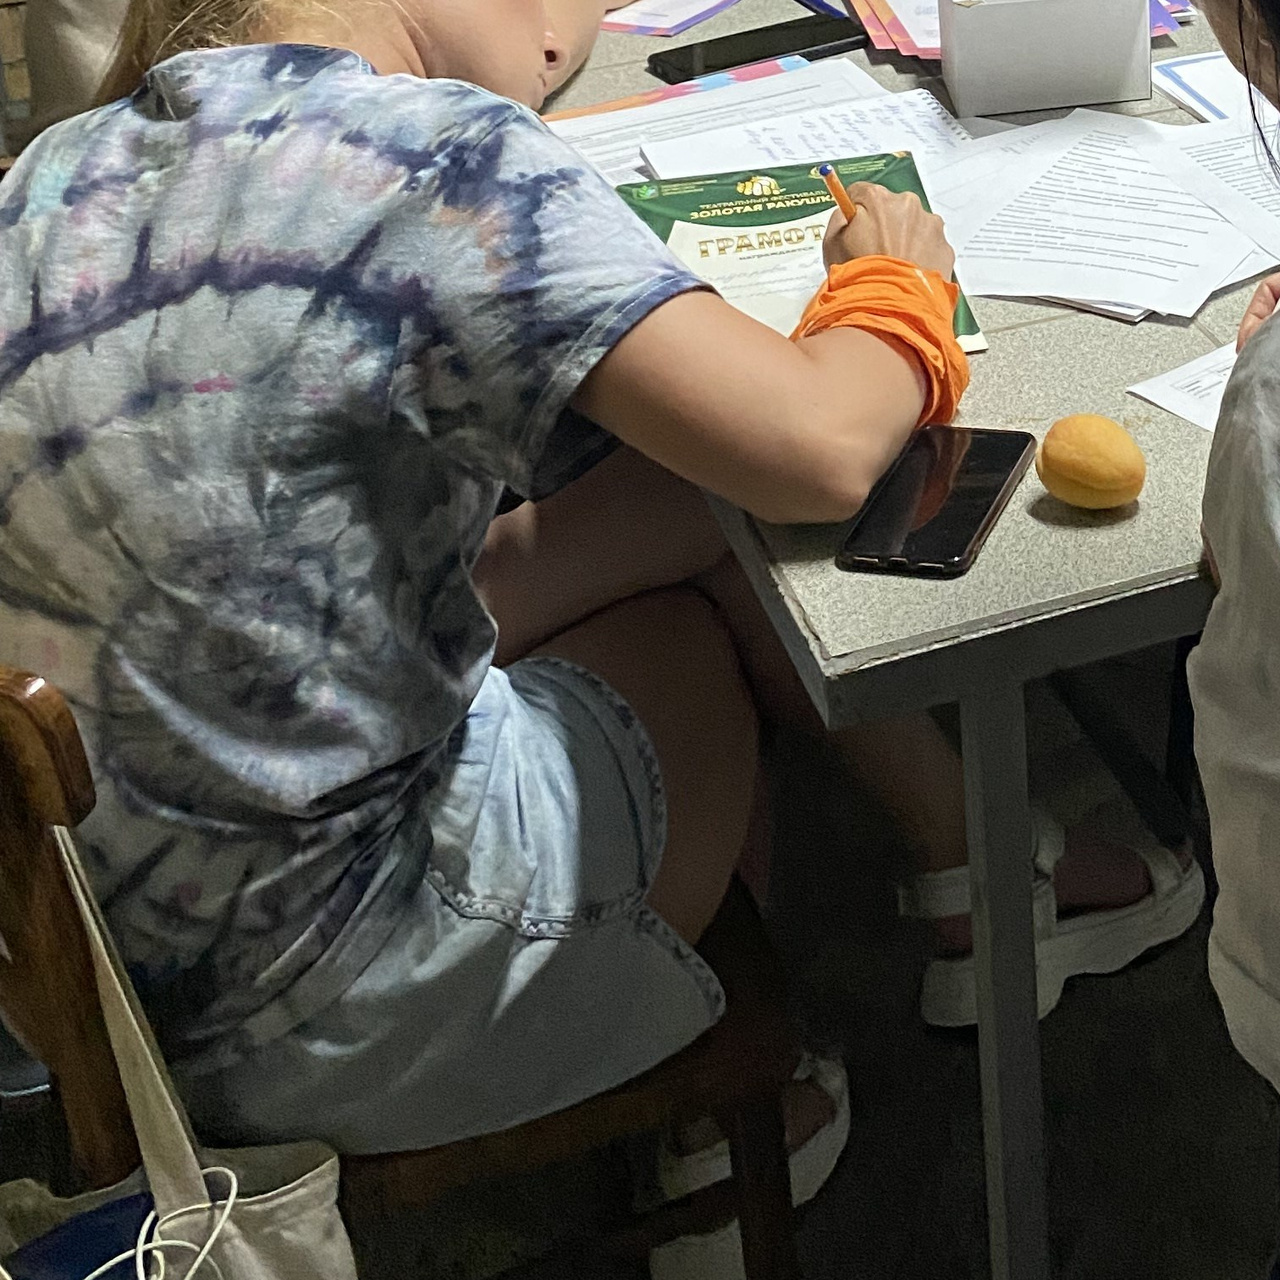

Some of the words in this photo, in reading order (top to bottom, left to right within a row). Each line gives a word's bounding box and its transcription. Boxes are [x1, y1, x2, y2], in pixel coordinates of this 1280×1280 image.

[699, 197, 769, 209] ТЕАТРАЛЬНЫЙ
[770, 190, 827, 201] ФЕСТИВАЛЬ
[690, 203, 763, 220] ЗОЛОТАЯ
[697, 224, 826, 258] ГРАМОТ
